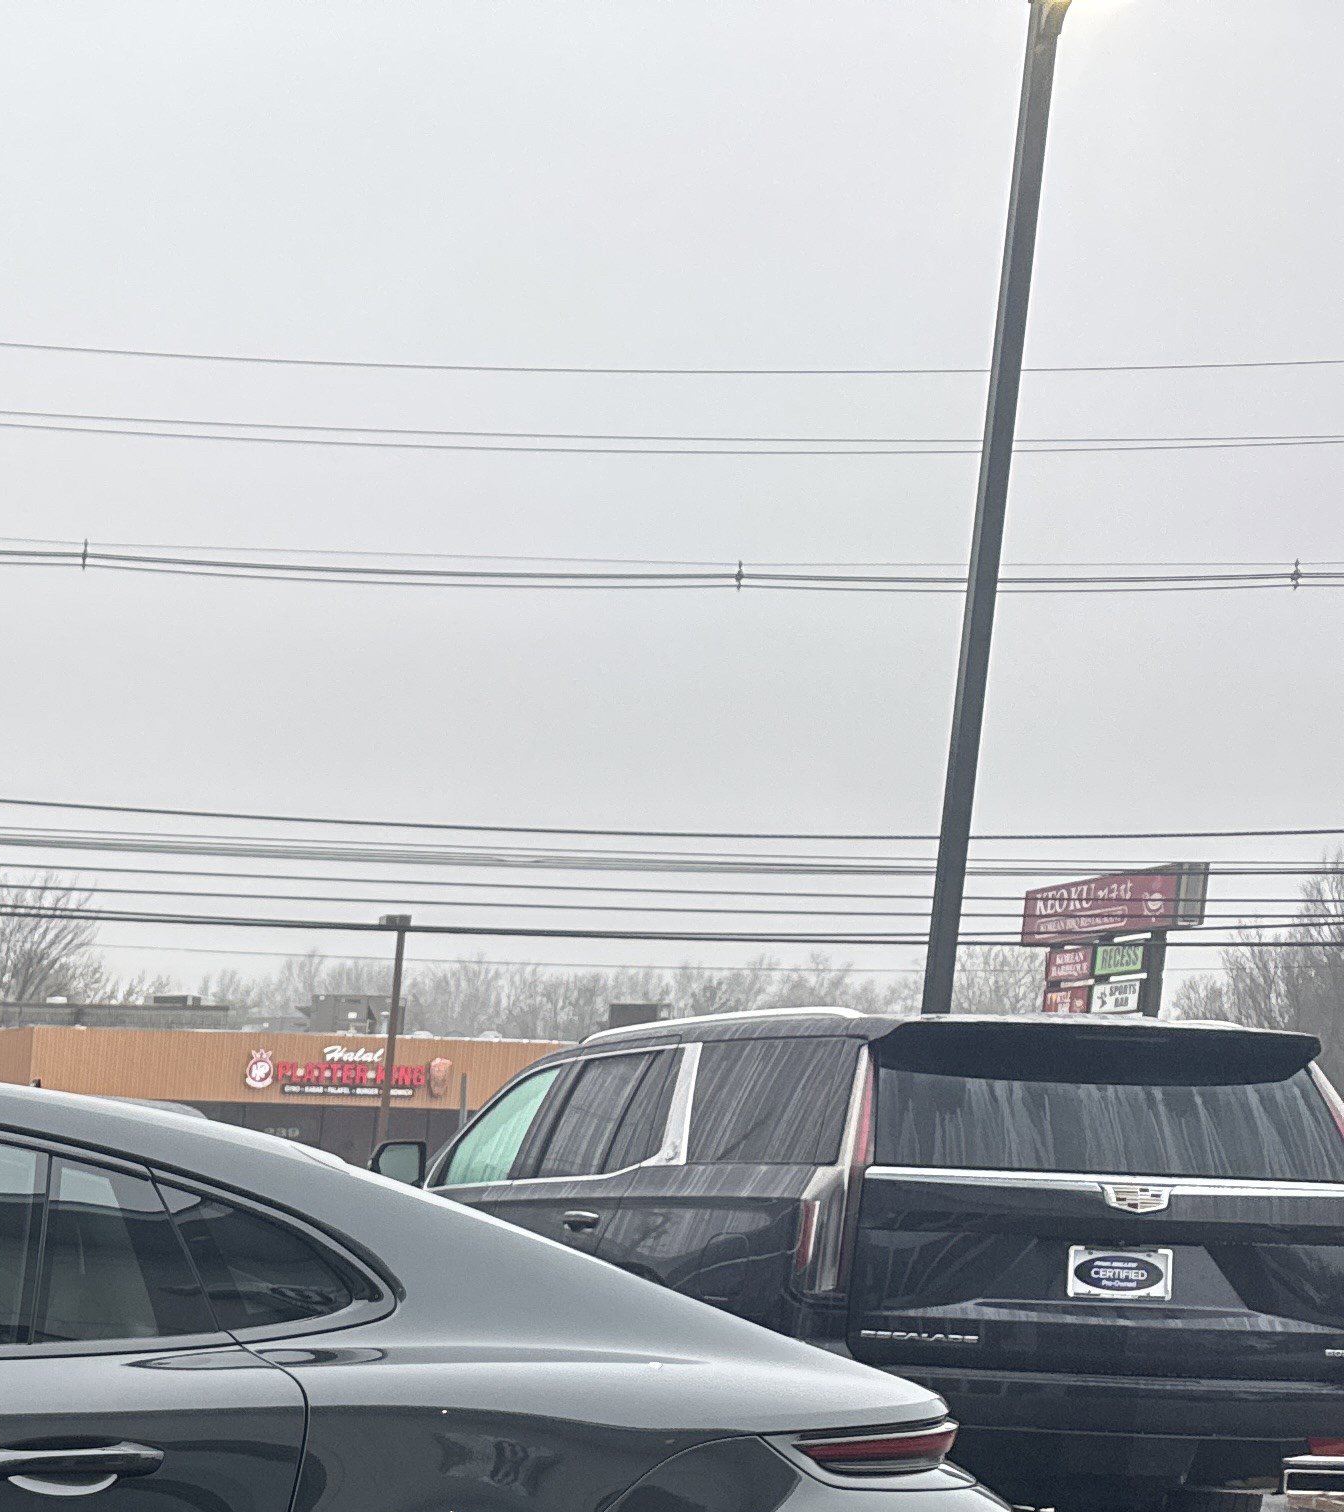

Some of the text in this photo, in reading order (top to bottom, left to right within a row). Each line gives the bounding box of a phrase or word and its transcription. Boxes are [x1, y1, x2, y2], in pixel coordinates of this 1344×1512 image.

[1102, 946, 1139, 969] RECESS
[1109, 983, 1137, 996] SPORTS
[323, 1045, 385, 1062] Halal
[277, 1061, 367, 1084] PLATTER
[1090, 1267, 1148, 1280] CERTIFIED
